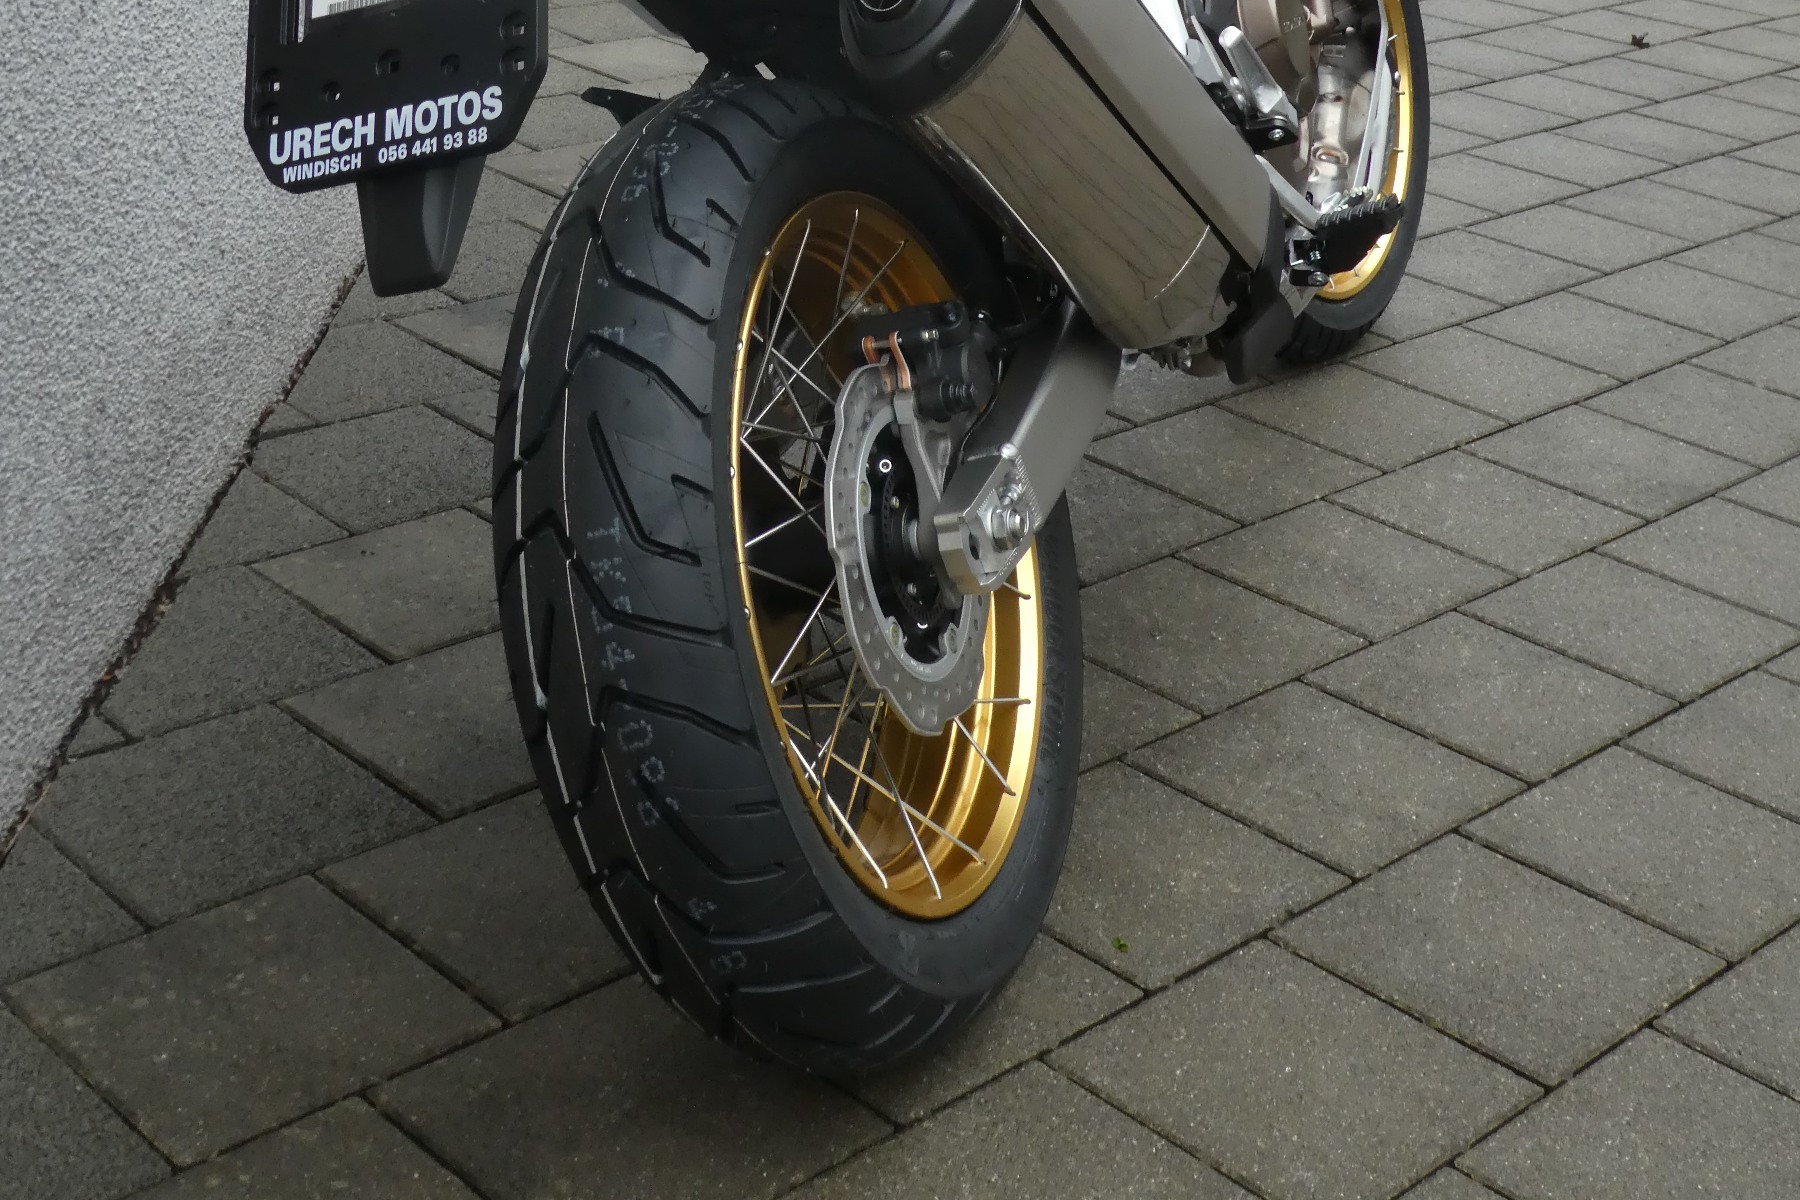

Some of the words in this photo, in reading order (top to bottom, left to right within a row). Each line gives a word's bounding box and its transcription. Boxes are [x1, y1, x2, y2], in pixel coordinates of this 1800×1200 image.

[269, 112, 376, 166] URECH
[384, 85, 503, 142] MOTOS
[282, 152, 362, 185] WINDISCH
[378, 143, 408, 165] 056
[411, 136, 438, 157] 441
[442, 131, 463, 151] 93
[467, 126, 488, 145] 88
